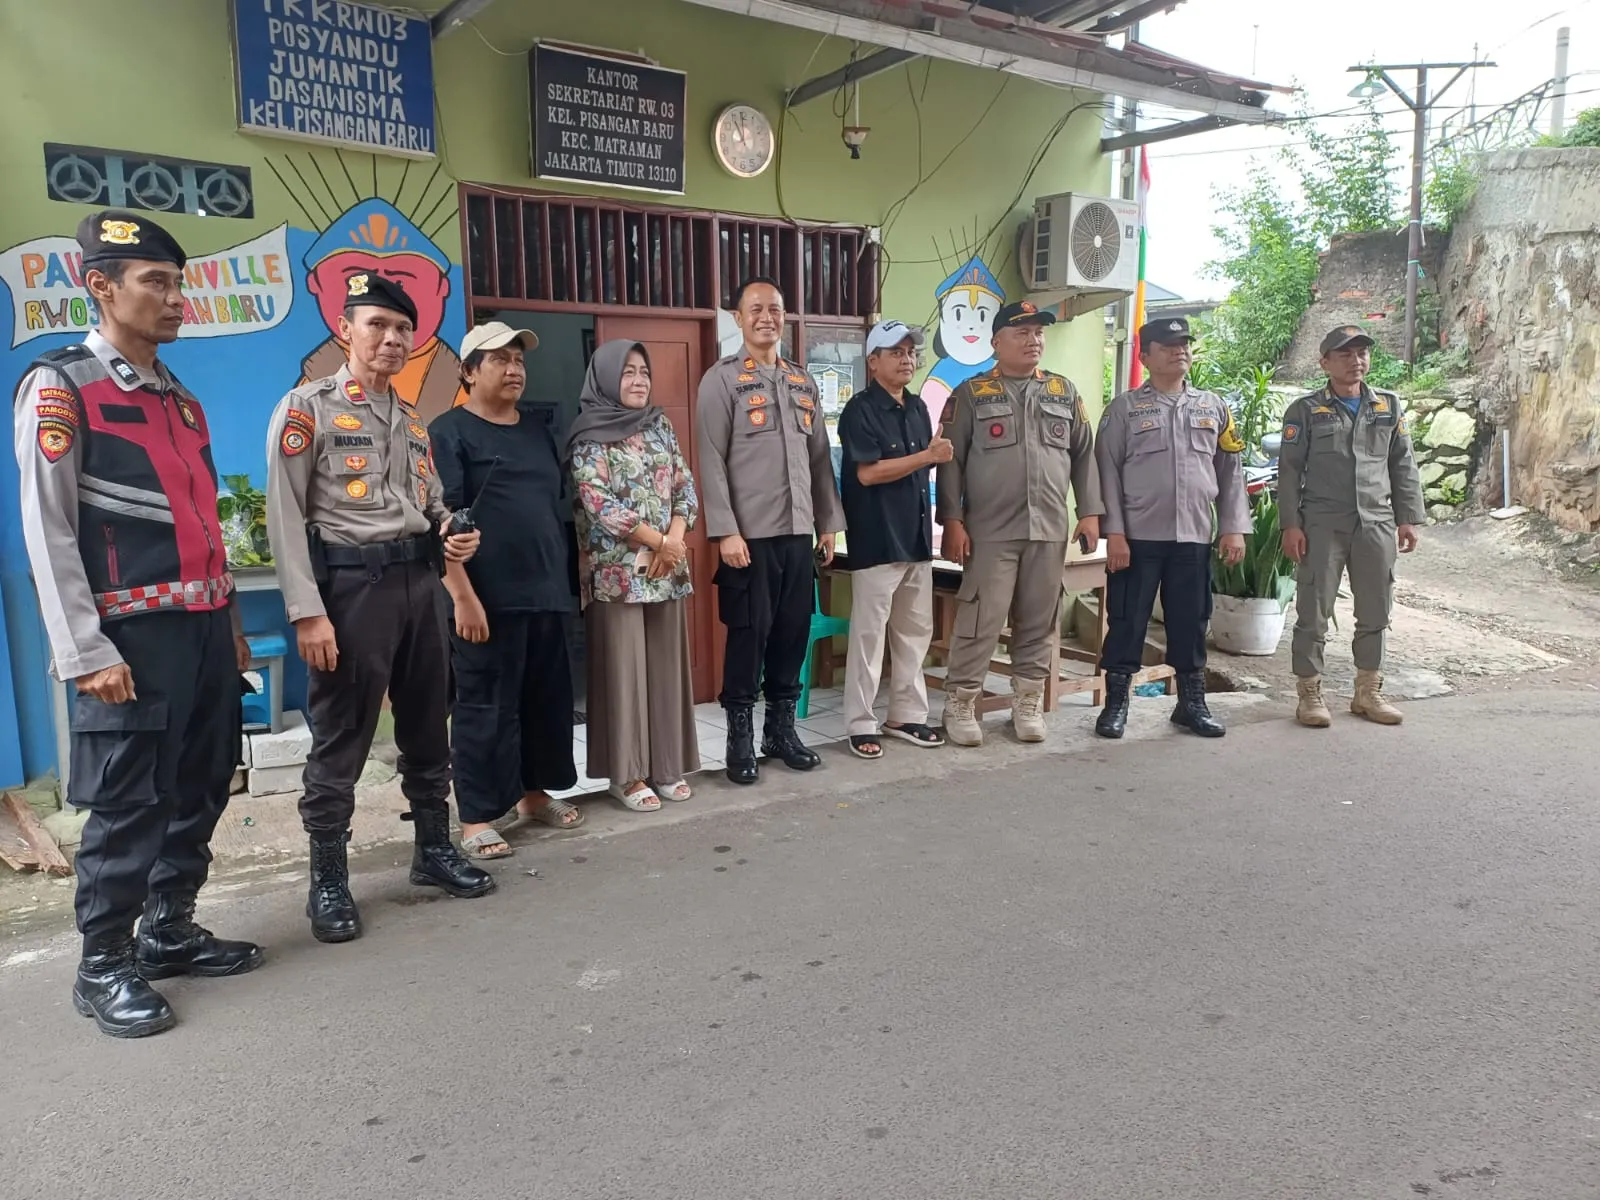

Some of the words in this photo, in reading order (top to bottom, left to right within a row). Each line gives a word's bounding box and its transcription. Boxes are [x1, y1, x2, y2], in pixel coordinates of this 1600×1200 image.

[268, 17, 399, 68] POSYANDU
[270, 50, 404, 95] JUMANTIK
[587, 67, 638, 91] KANTOR
[268, 75, 406, 122] DASAWISMA
[547, 83, 634, 113] SEKRETARIAT
[638, 98, 658, 117] RW.
[660, 102, 675, 119] 03
[384, 121, 430, 152] BARU
[547, 106, 576, 126] KEL.
[580, 111, 640, 135] PISANGAN
[643, 121, 675, 140] BARU
[561, 131, 591, 151] KEC.
[594, 136, 662, 160] MATRAMAN
[544, 152, 602, 174] JAKARTA
[606, 160, 645, 180] TIMUR
[648, 165, 677, 183] 13110
[214, 294, 275, 323] BARU
